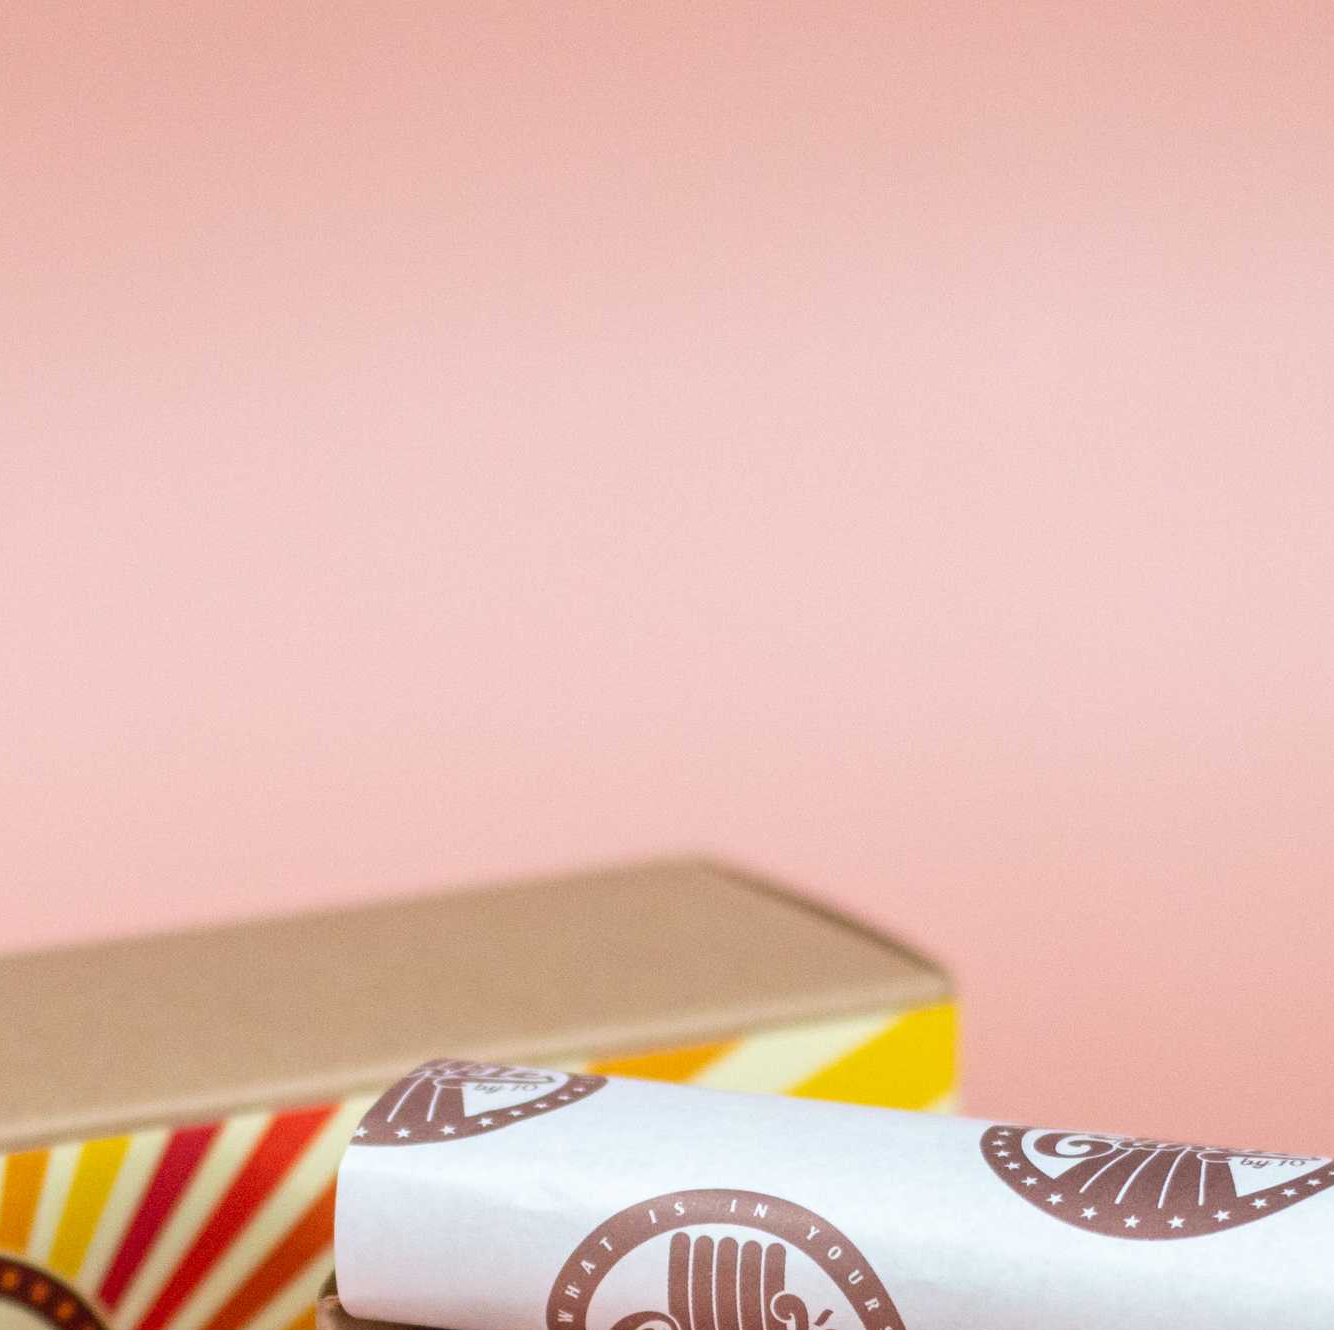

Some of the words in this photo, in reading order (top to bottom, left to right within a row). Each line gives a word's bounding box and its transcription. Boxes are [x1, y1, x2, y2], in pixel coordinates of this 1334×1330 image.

[557, 1236, 614, 1323] WHAT
[647, 1201, 685, 1224] IS
[729, 1199, 769, 1219] IN
